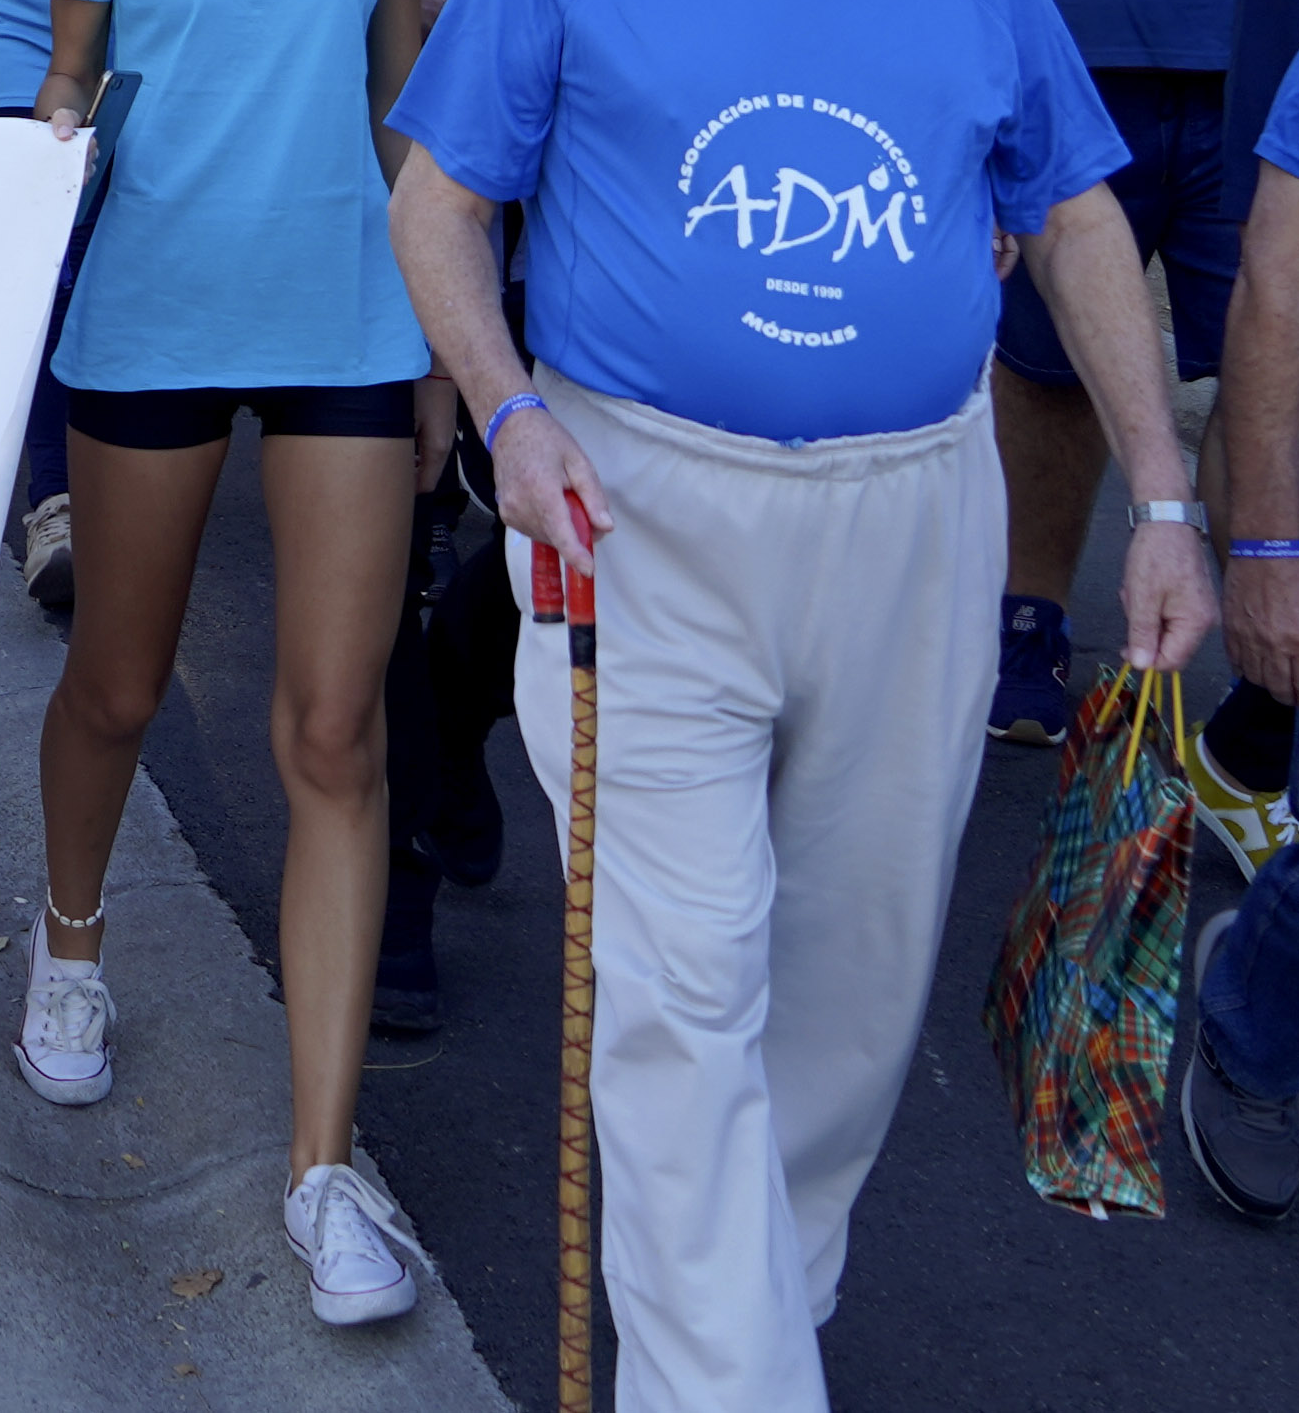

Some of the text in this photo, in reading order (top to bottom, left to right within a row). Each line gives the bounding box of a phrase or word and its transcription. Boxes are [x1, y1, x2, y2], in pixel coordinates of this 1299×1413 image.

[677, 93, 927, 225] ASOCIACIÓN DE DIABÉTICOS DE
[684, 164, 915, 264] ADM
[765, 277, 843, 300] DESDE 1990
[741, 310, 858, 348] MÓSTOLES
